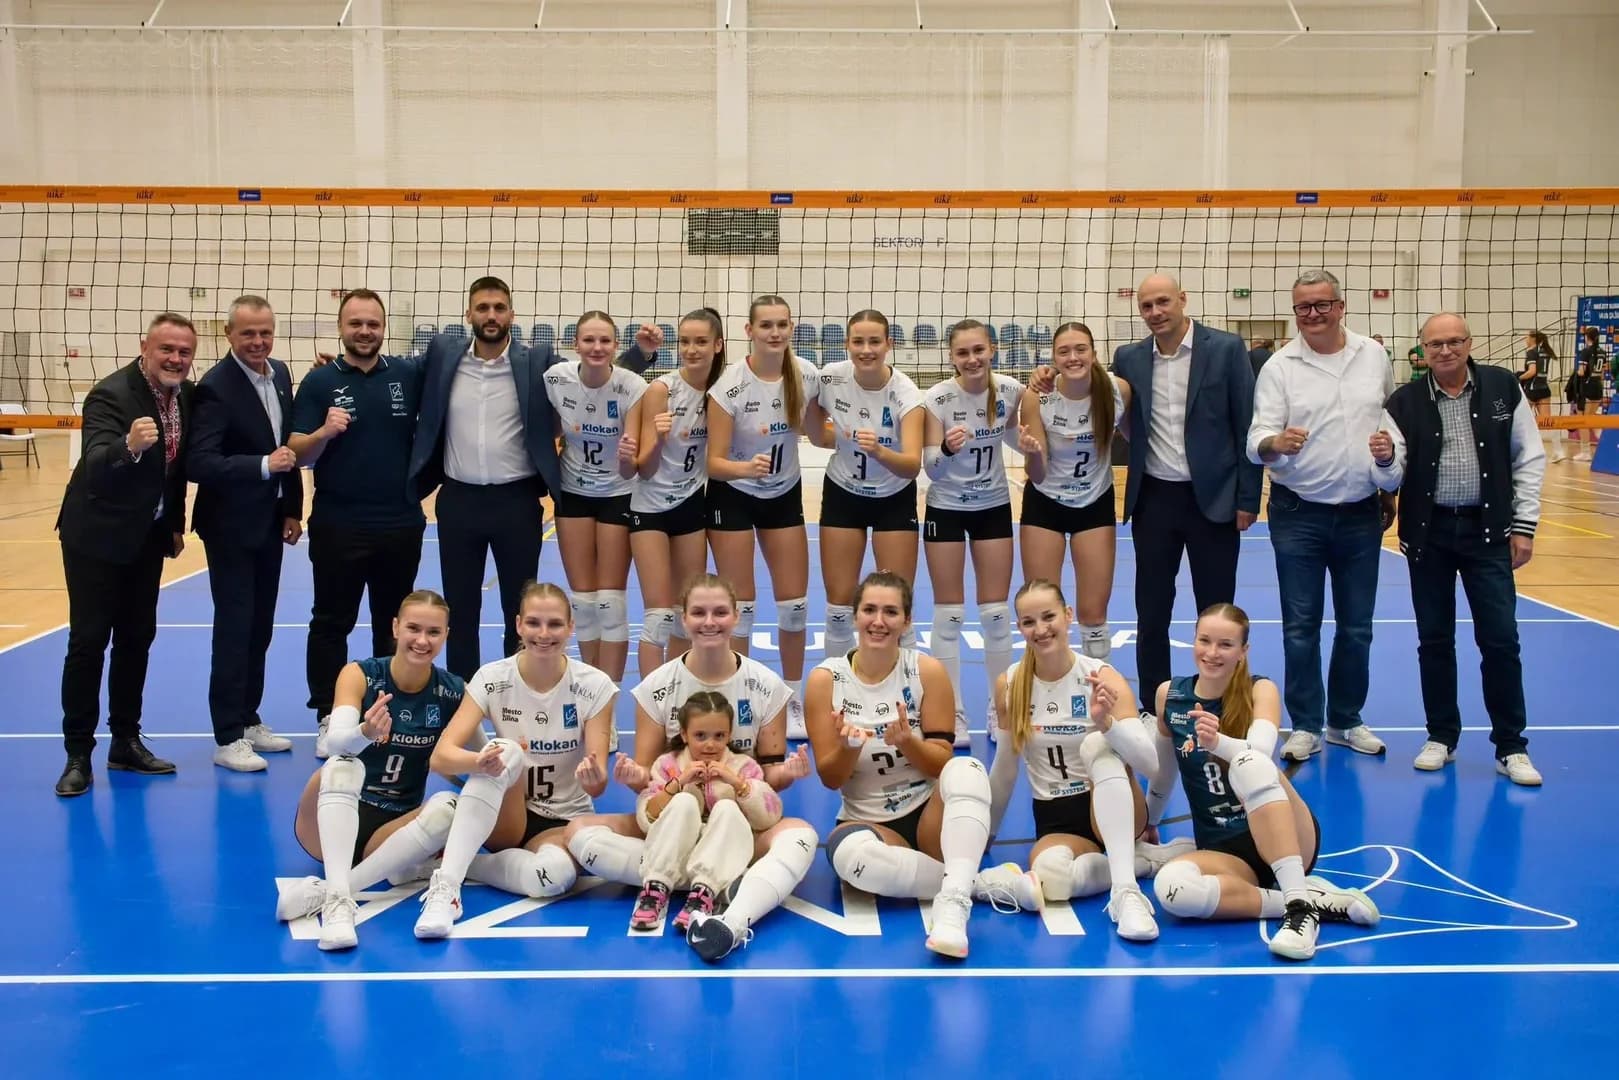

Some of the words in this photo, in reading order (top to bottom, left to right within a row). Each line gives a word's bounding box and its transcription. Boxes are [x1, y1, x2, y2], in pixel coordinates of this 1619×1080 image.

[873, 236, 924, 249] SEKTOR
[936, 236, 945, 249] F
[582, 423, 619, 434] Klokan
[690, 426, 708, 436] Klo
[770, 422, 788, 432] Klo
[583, 440, 603, 466] 12
[684, 444, 698, 473] 6
[768, 443, 784, 474] 11
[852, 449, 868, 480] 3
[970, 445, 994, 475] 77
[1073, 450, 1090, 478] 2
[714, 509, 722, 525] 11
[926, 520, 937, 537] 77
[502, 707, 522, 716] Mesto
[391, 733, 435, 745] Klokan
[530, 739, 578, 751] Klokan
[381, 754, 405, 783] 9
[1047, 745, 1069, 780] 4
[527, 764, 555, 801] 15
[1203, 762, 1226, 796] 8
